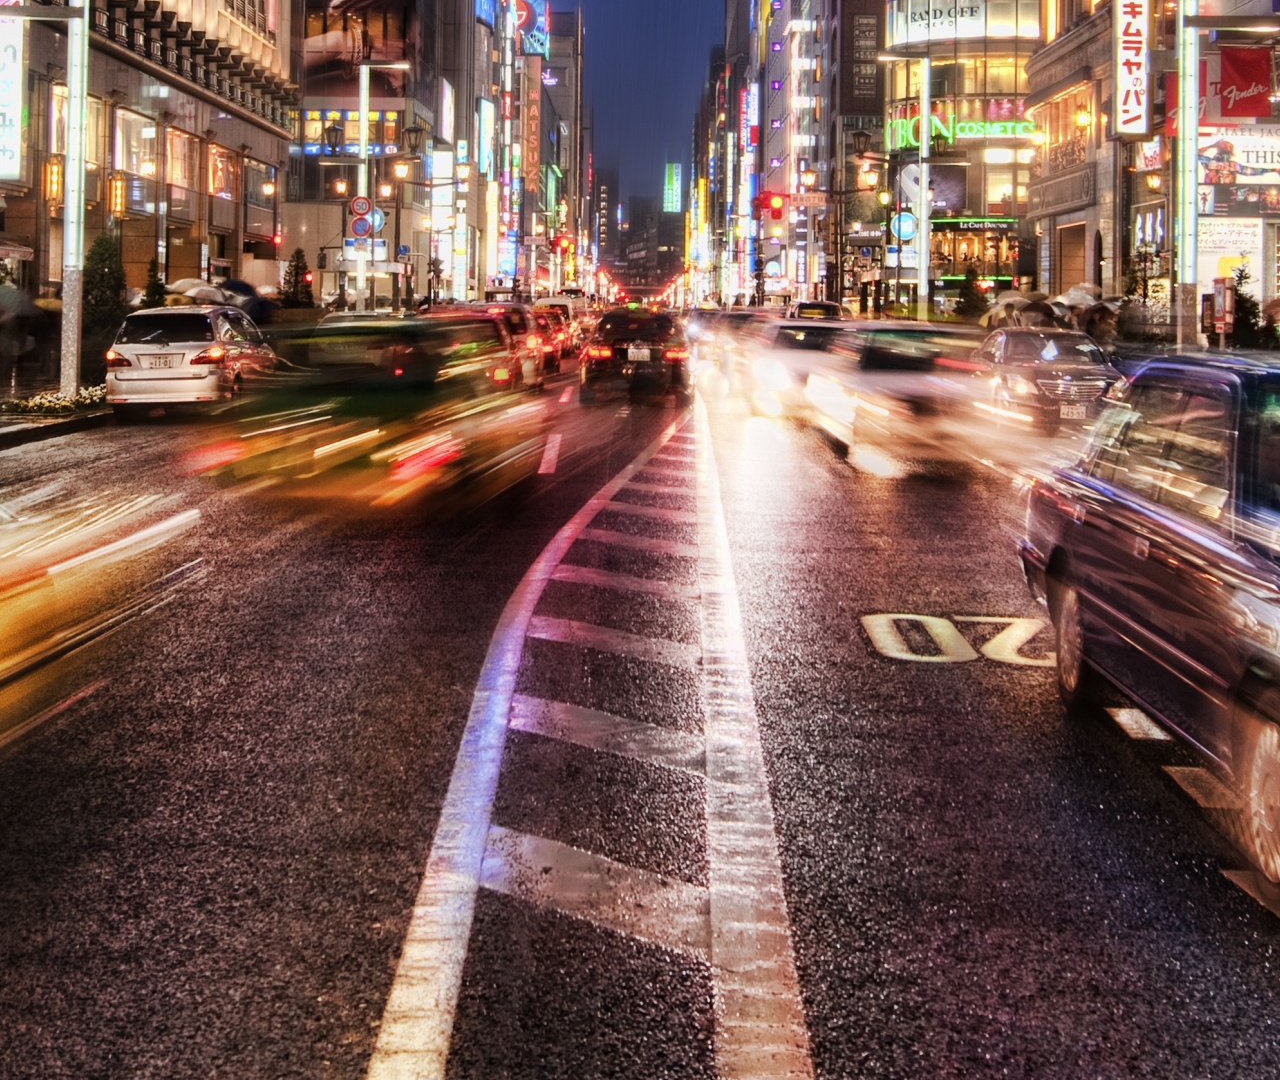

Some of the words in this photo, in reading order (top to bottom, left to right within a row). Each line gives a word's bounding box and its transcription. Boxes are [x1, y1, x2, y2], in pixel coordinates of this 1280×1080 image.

[1122, 1, 1146, 126] キムラヤのパン
[1223, 81, 1269, 110] Fender
[355, 201, 368, 211] 50
